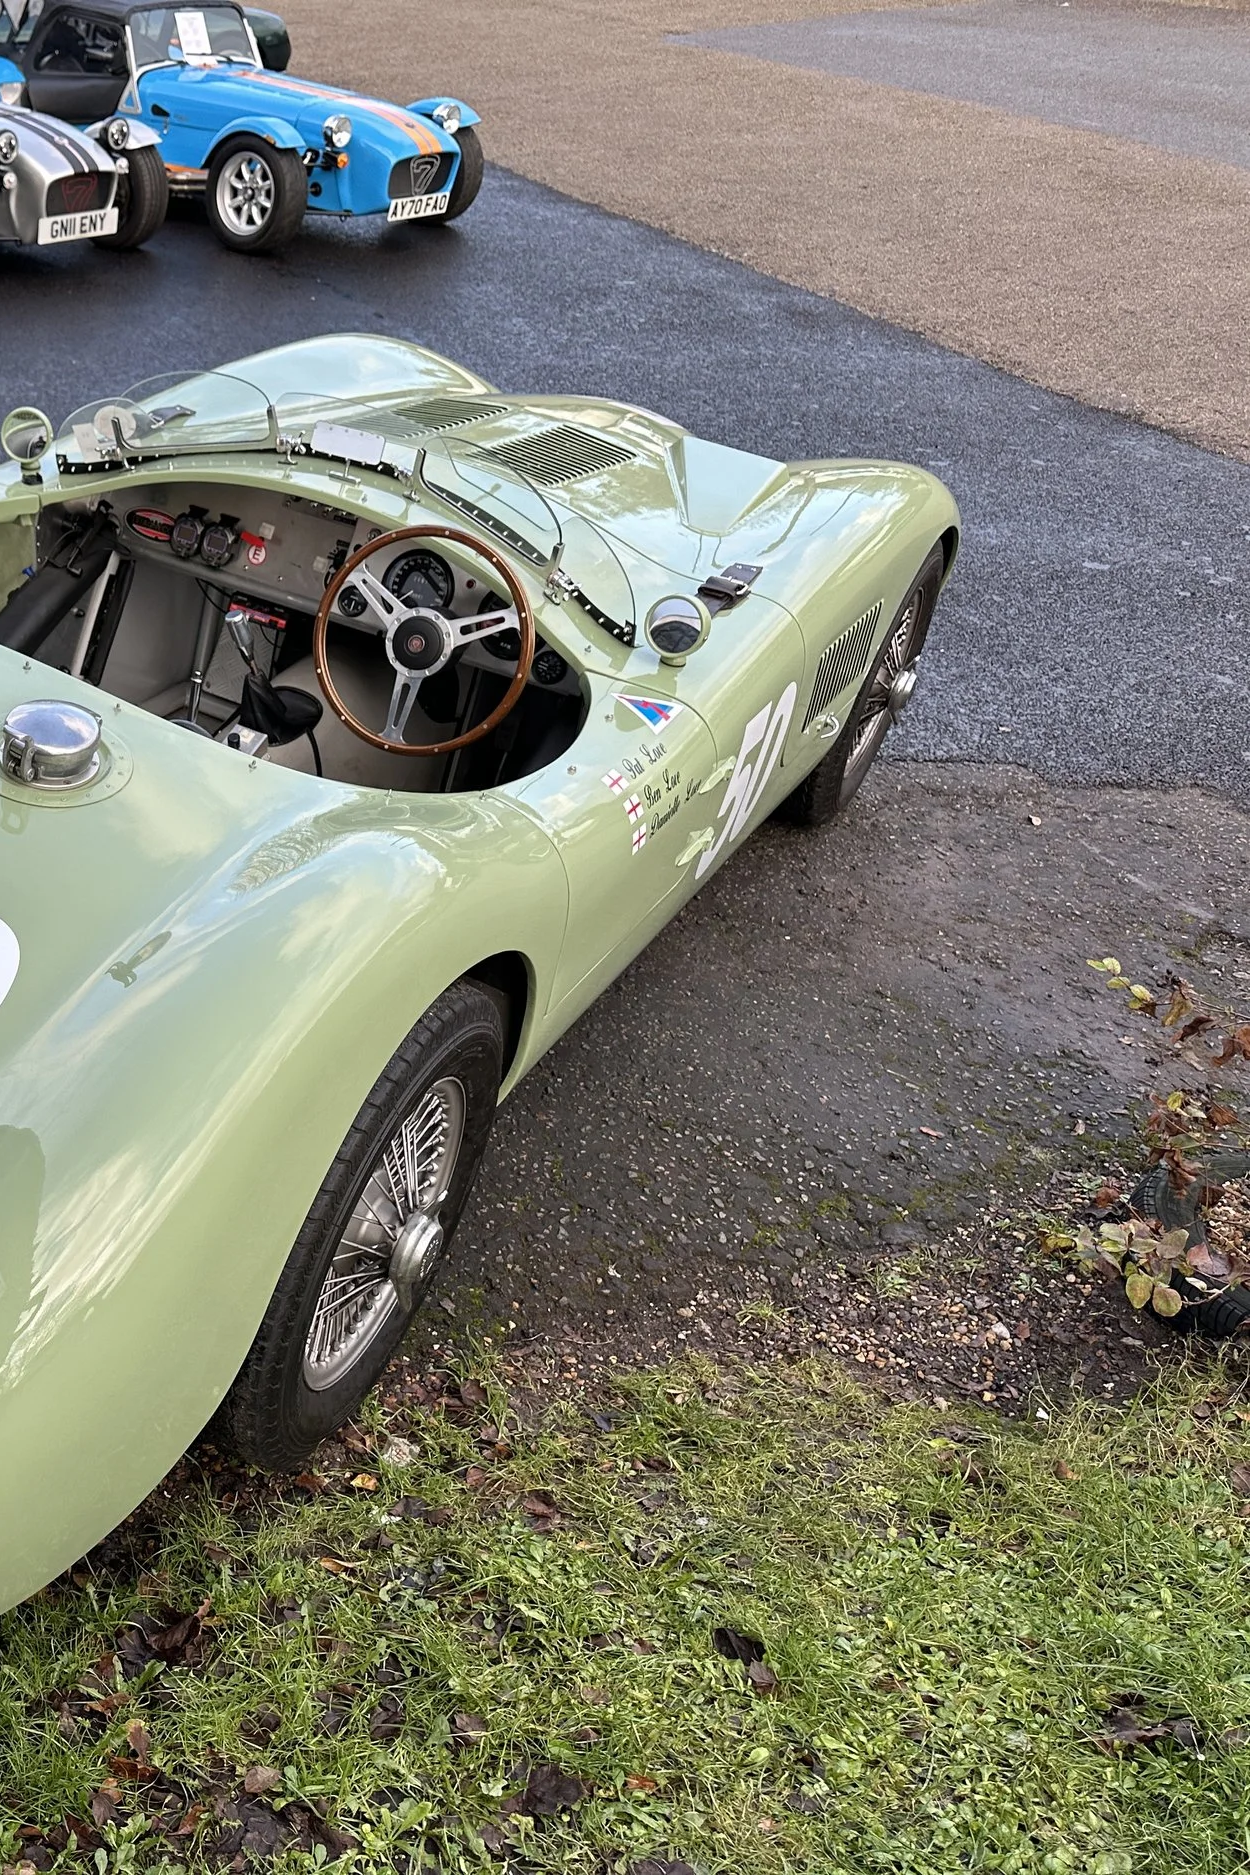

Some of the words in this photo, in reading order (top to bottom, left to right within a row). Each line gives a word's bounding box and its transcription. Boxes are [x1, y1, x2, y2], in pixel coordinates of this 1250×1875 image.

[390, 199, 423, 218] AY70
[423, 195, 447, 213] FAO
[50, 217, 77, 239] GN11
[79, 212, 107, 234] ENY
[252, 547, 263, 561] E
[622, 757, 645, 780] Pat
[639, 742, 667, 765] Love
[643, 784, 662, 809] Ben
[662, 768, 681, 793] Love
[695, 681, 798, 880] 50
